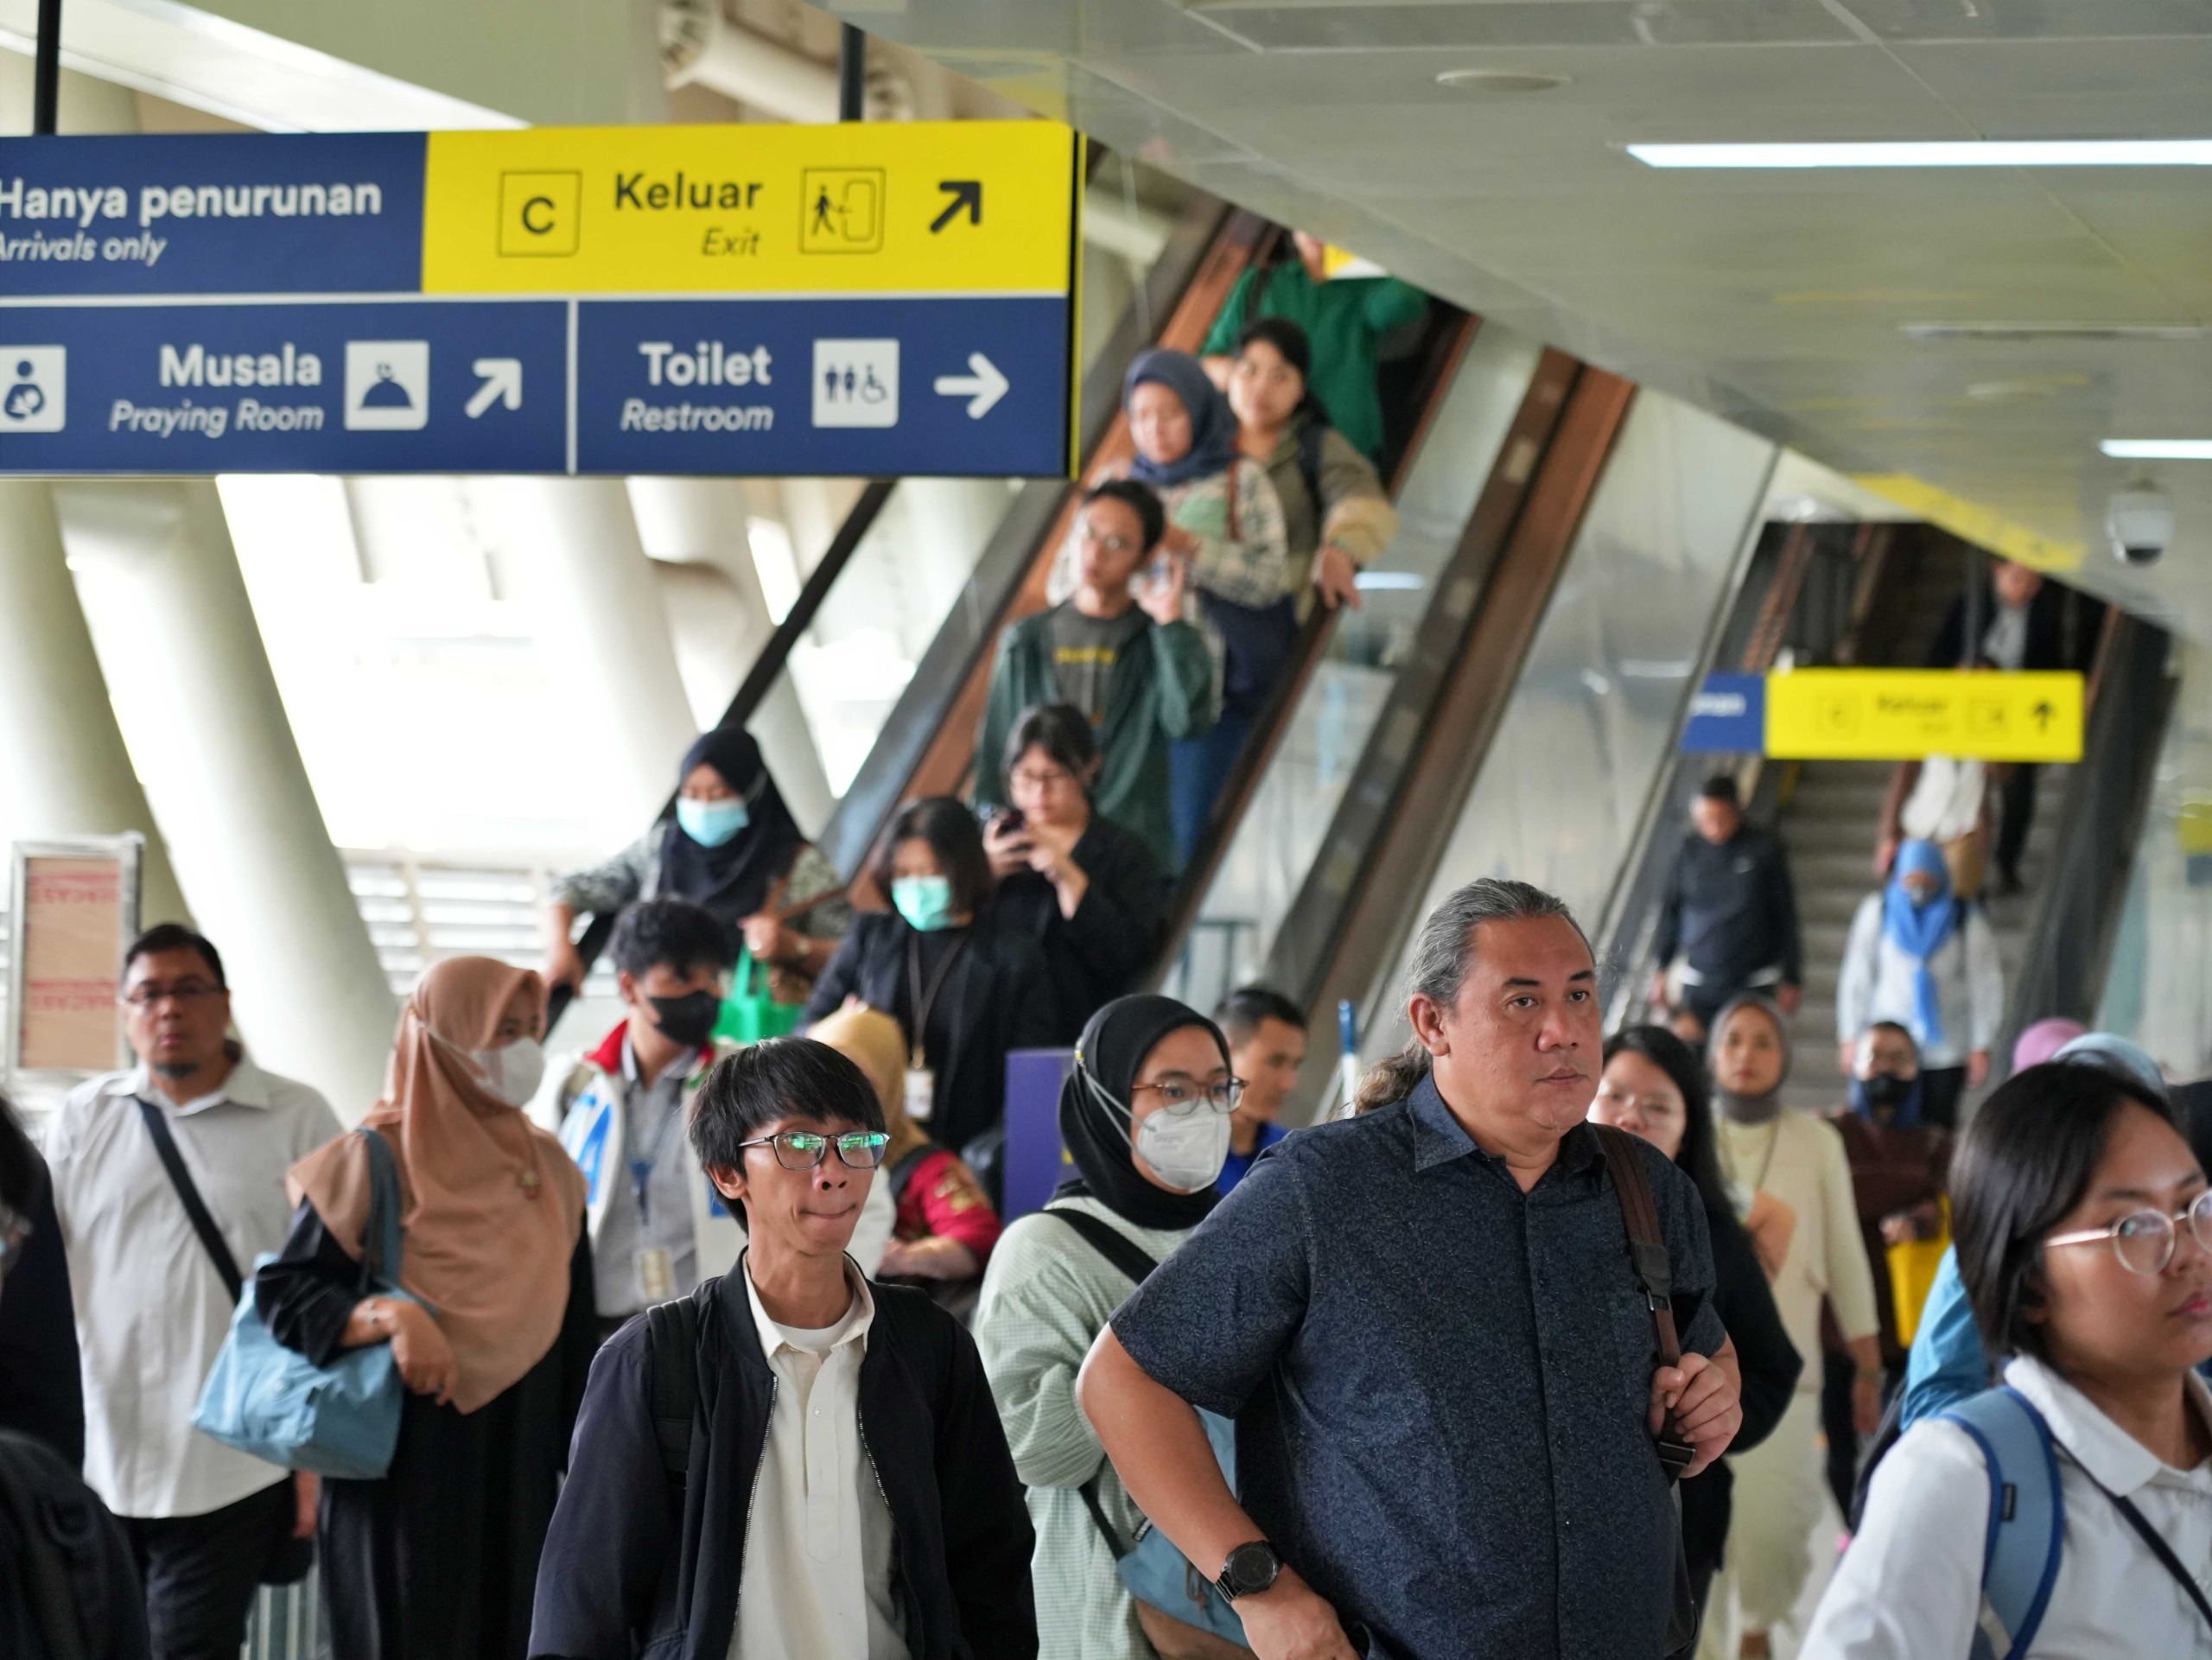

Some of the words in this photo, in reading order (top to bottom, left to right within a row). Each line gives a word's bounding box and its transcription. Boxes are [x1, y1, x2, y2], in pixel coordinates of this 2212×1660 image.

[0, 178, 128, 227] Hanya
[139, 181, 382, 226] penurunan
[614, 172, 763, 210] Keluar
[522, 195, 556, 235] C
[102, 230, 167, 267] only
[701, 227, 760, 257] Exit
[159, 342, 322, 387] Musala
[639, 341, 772, 386] Toilet
[109, 399, 229, 439] Praying
[235, 398, 325, 432] Room
[620, 398, 774, 432] Restroom
